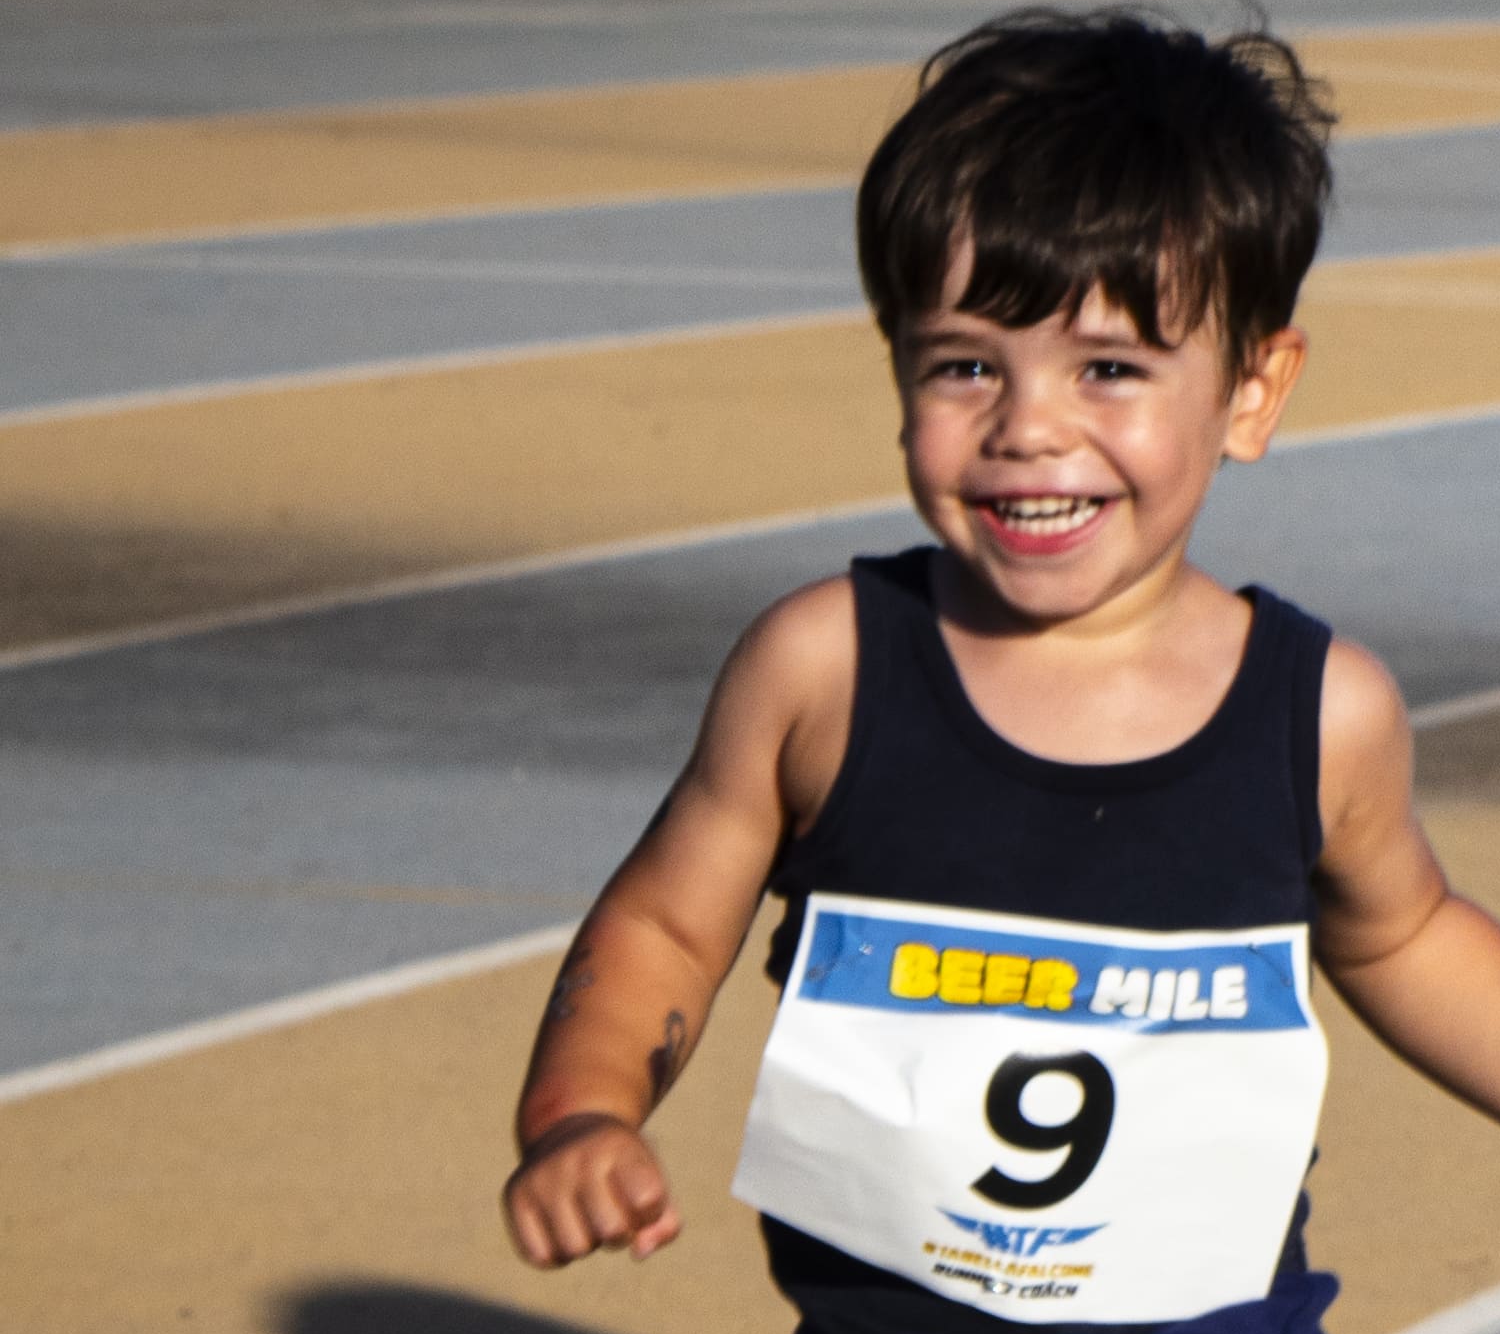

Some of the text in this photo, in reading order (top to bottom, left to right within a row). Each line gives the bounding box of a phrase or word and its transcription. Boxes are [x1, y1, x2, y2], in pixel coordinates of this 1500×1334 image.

[889, 942, 1248, 1021] BEER MILE
[969, 1047, 1117, 1211] 9
[1018, 1281, 1078, 1298] COACH
